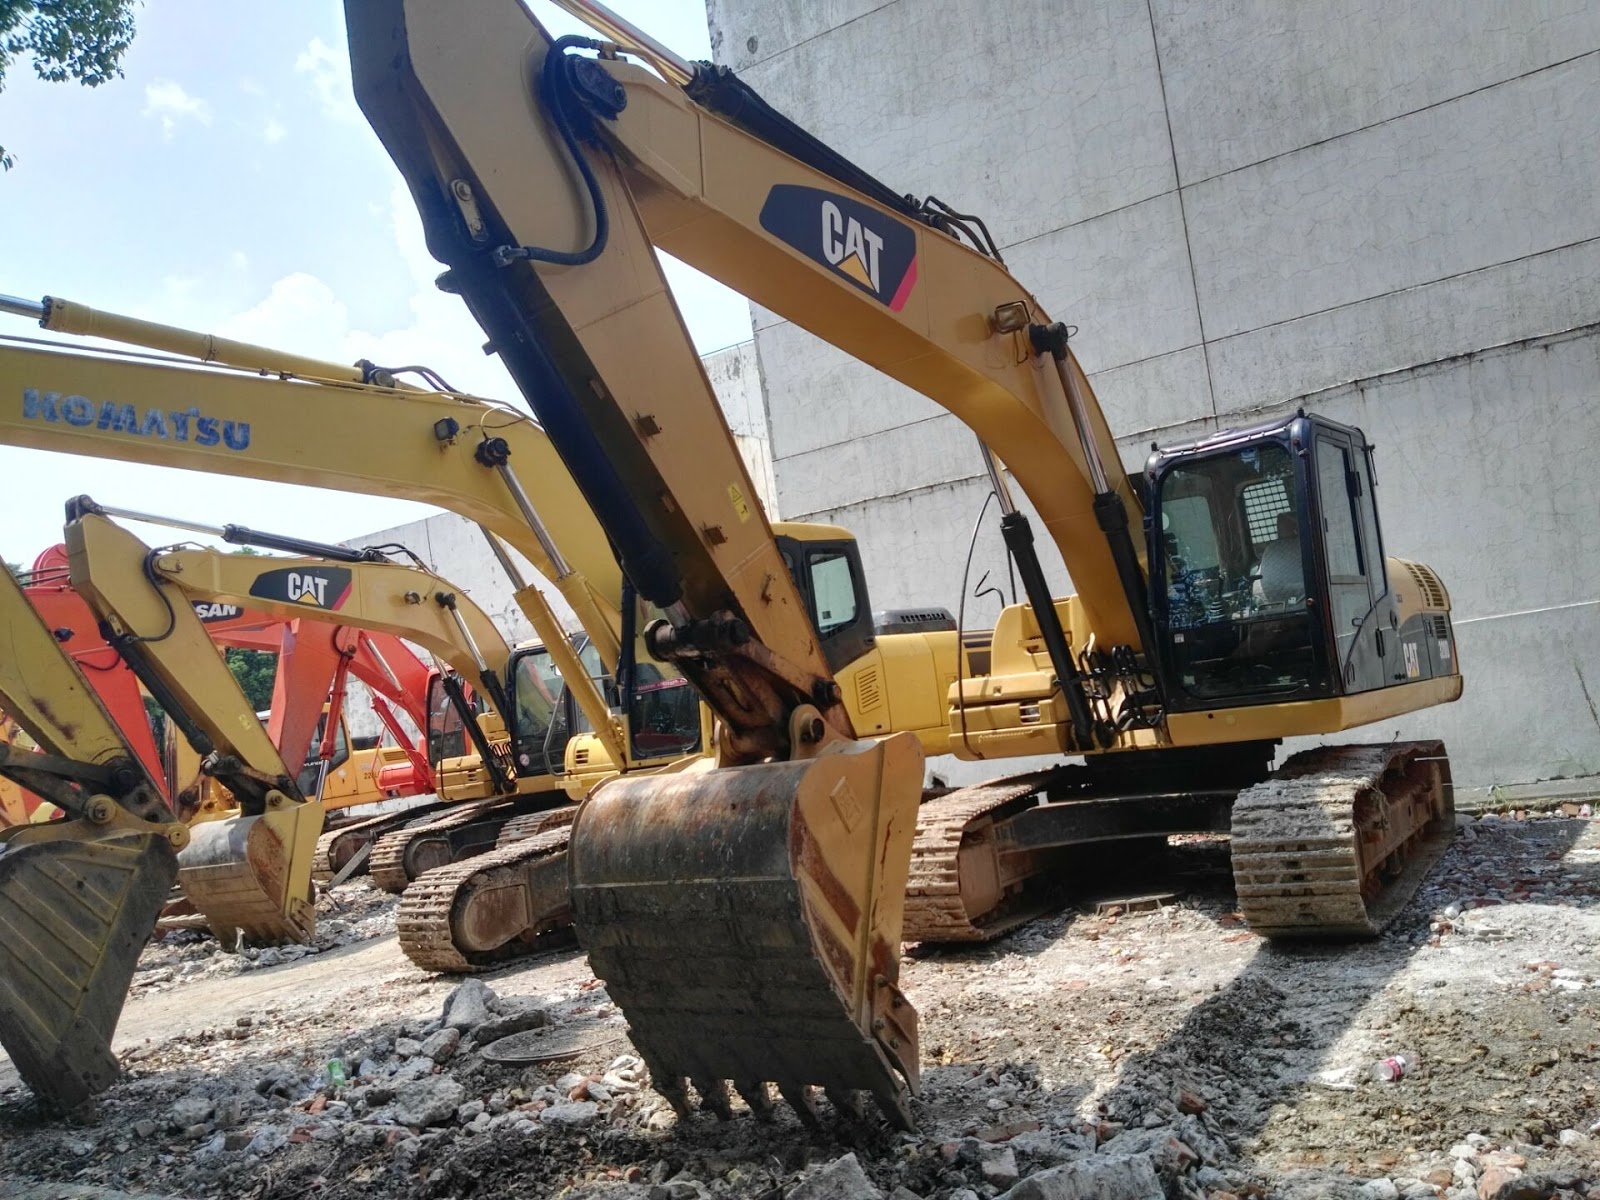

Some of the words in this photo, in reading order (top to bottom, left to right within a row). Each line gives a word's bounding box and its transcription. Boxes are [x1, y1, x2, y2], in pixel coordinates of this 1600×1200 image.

[821, 200, 884, 294] CAT
[22, 387, 251, 450] KOMATSU
[287, 572, 329, 606] CAT
[1402, 642, 1420, 678] CAT
